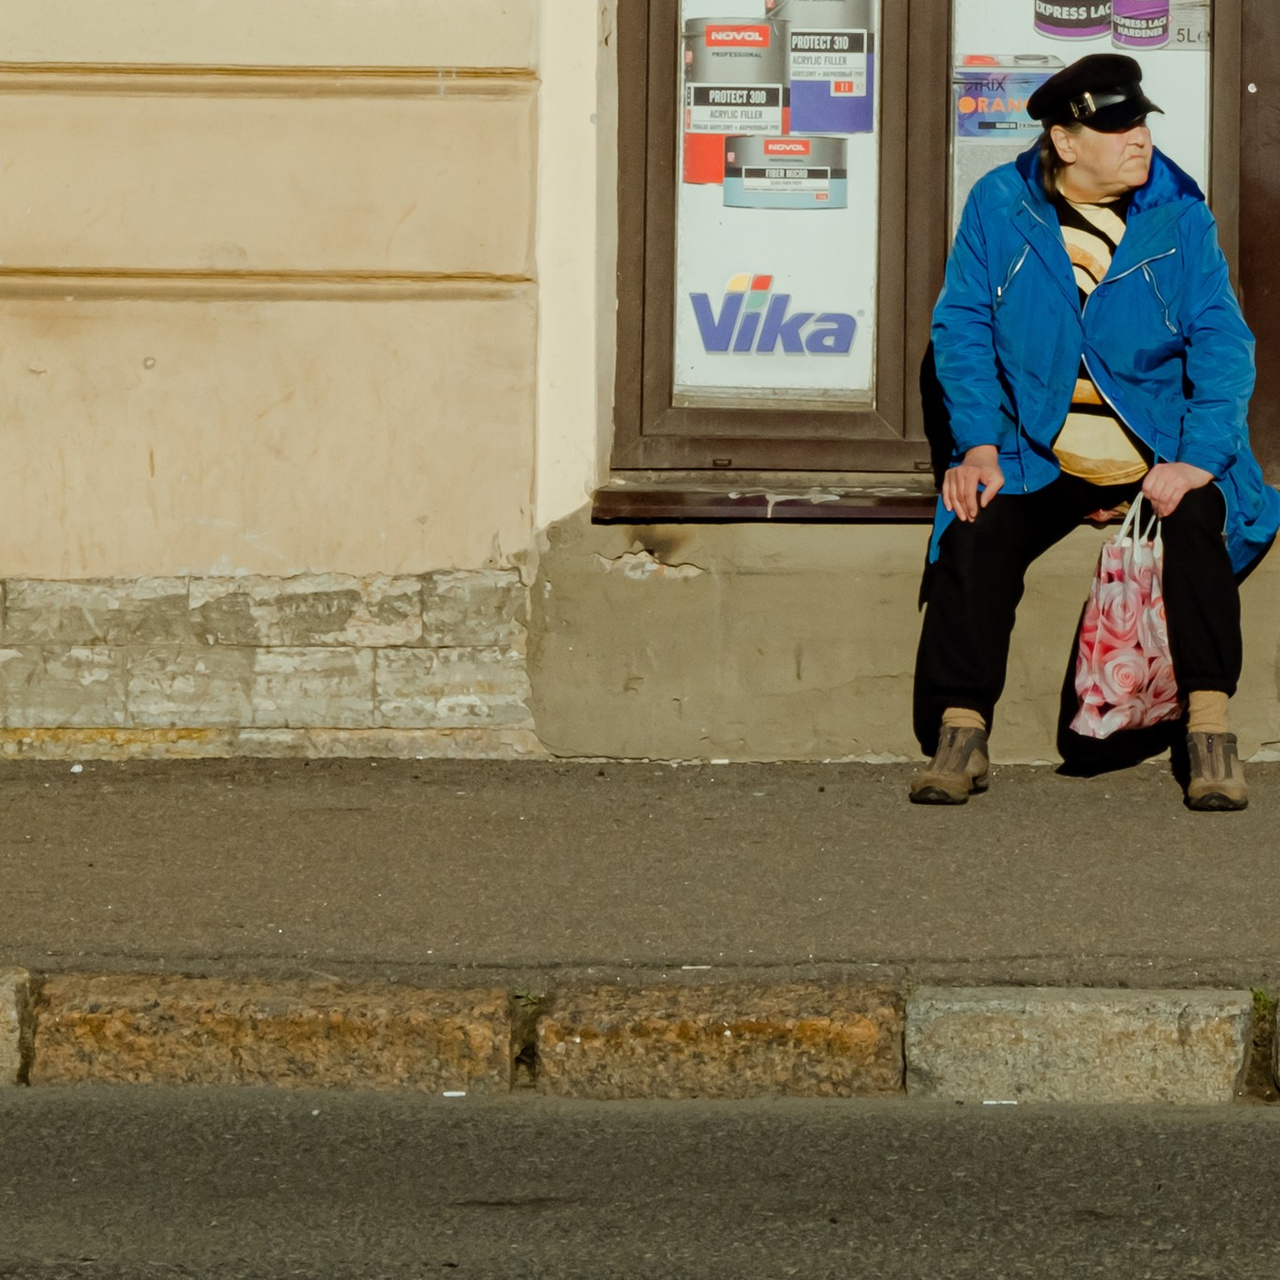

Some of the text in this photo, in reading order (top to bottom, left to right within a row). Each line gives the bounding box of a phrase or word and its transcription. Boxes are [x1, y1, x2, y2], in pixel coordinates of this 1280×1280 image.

[1035, 0, 1088, 20] EXPRESS
[710, 31, 764, 41] NOVOL
[791, 35, 849, 50] PROTECT 310
[792, 55, 847, 66] ACRYLIC FILLER
[709, 89, 767, 104] PROTECT 300
[958, 96, 1030, 114] ORAN
[709, 109, 763, 120] ACRYLIC FILLER
[767, 143, 806, 152] NOVOL
[688, 290, 858, 357] Vika
